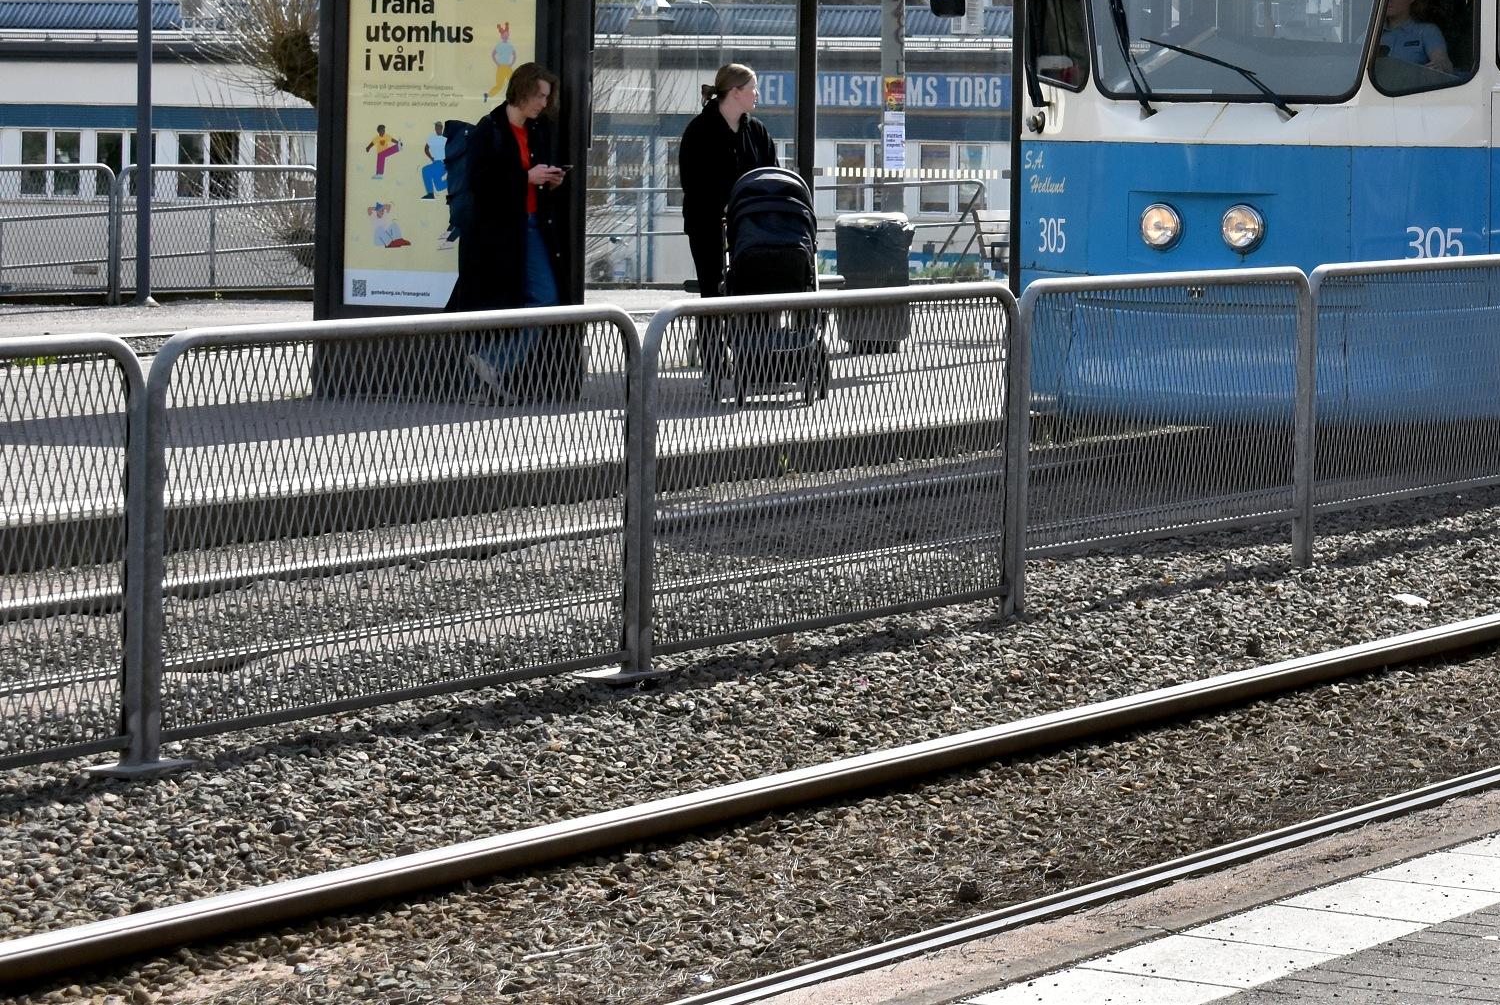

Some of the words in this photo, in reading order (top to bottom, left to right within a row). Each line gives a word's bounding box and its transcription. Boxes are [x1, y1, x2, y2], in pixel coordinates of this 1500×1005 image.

[366, 20, 474, 43] utomhus
[365, 48, 371, 71] i
[379, 45, 424, 72] vår!
[947, 76, 1001, 108] TORG
[1024, 150, 1044, 170] S.A.
[1030, 174, 1066, 194] Hedlund
[1038, 217, 1066, 253] 305
[1405, 226, 1464, 260] 305
